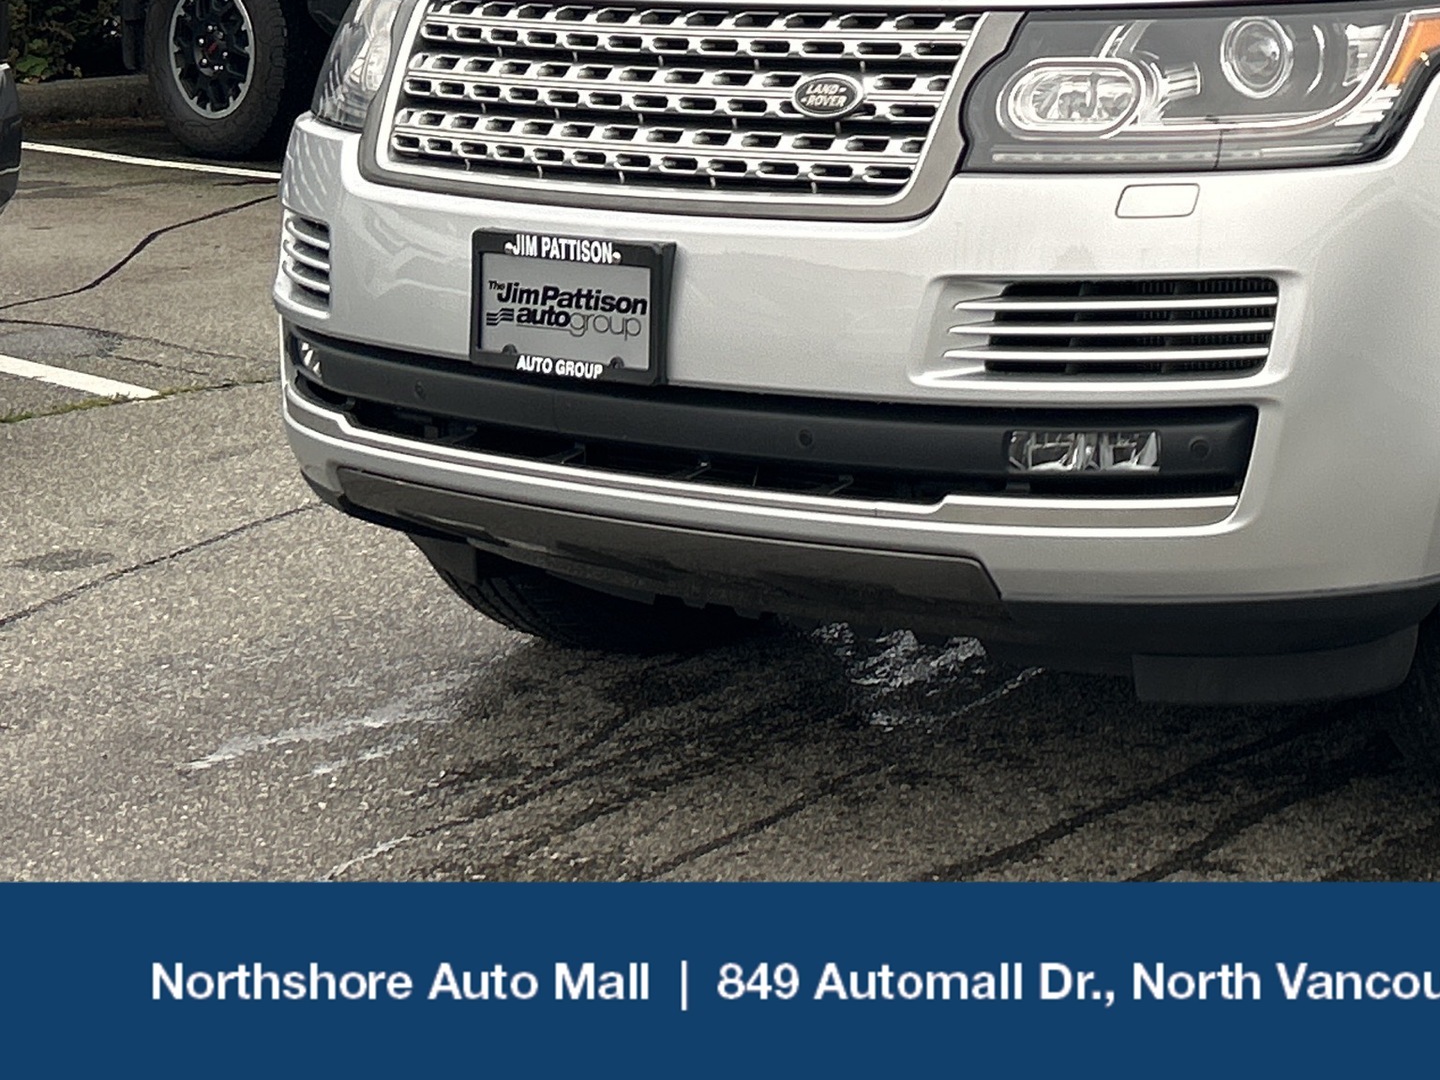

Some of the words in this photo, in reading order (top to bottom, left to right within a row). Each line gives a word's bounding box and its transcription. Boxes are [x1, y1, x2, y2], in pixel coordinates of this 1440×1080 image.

[805, 83, 840, 96] LAND
[806, 94, 848, 108] ROVER
[512, 233, 538, 256] JIM
[541, 237, 613, 264] PATTISON
[488, 279, 506, 292] The
[497, 281, 540, 306] Jim
[540, 286, 648, 315] Pattison
[516, 354, 554, 375] AUTO
[554, 358, 604, 380] GROUP
